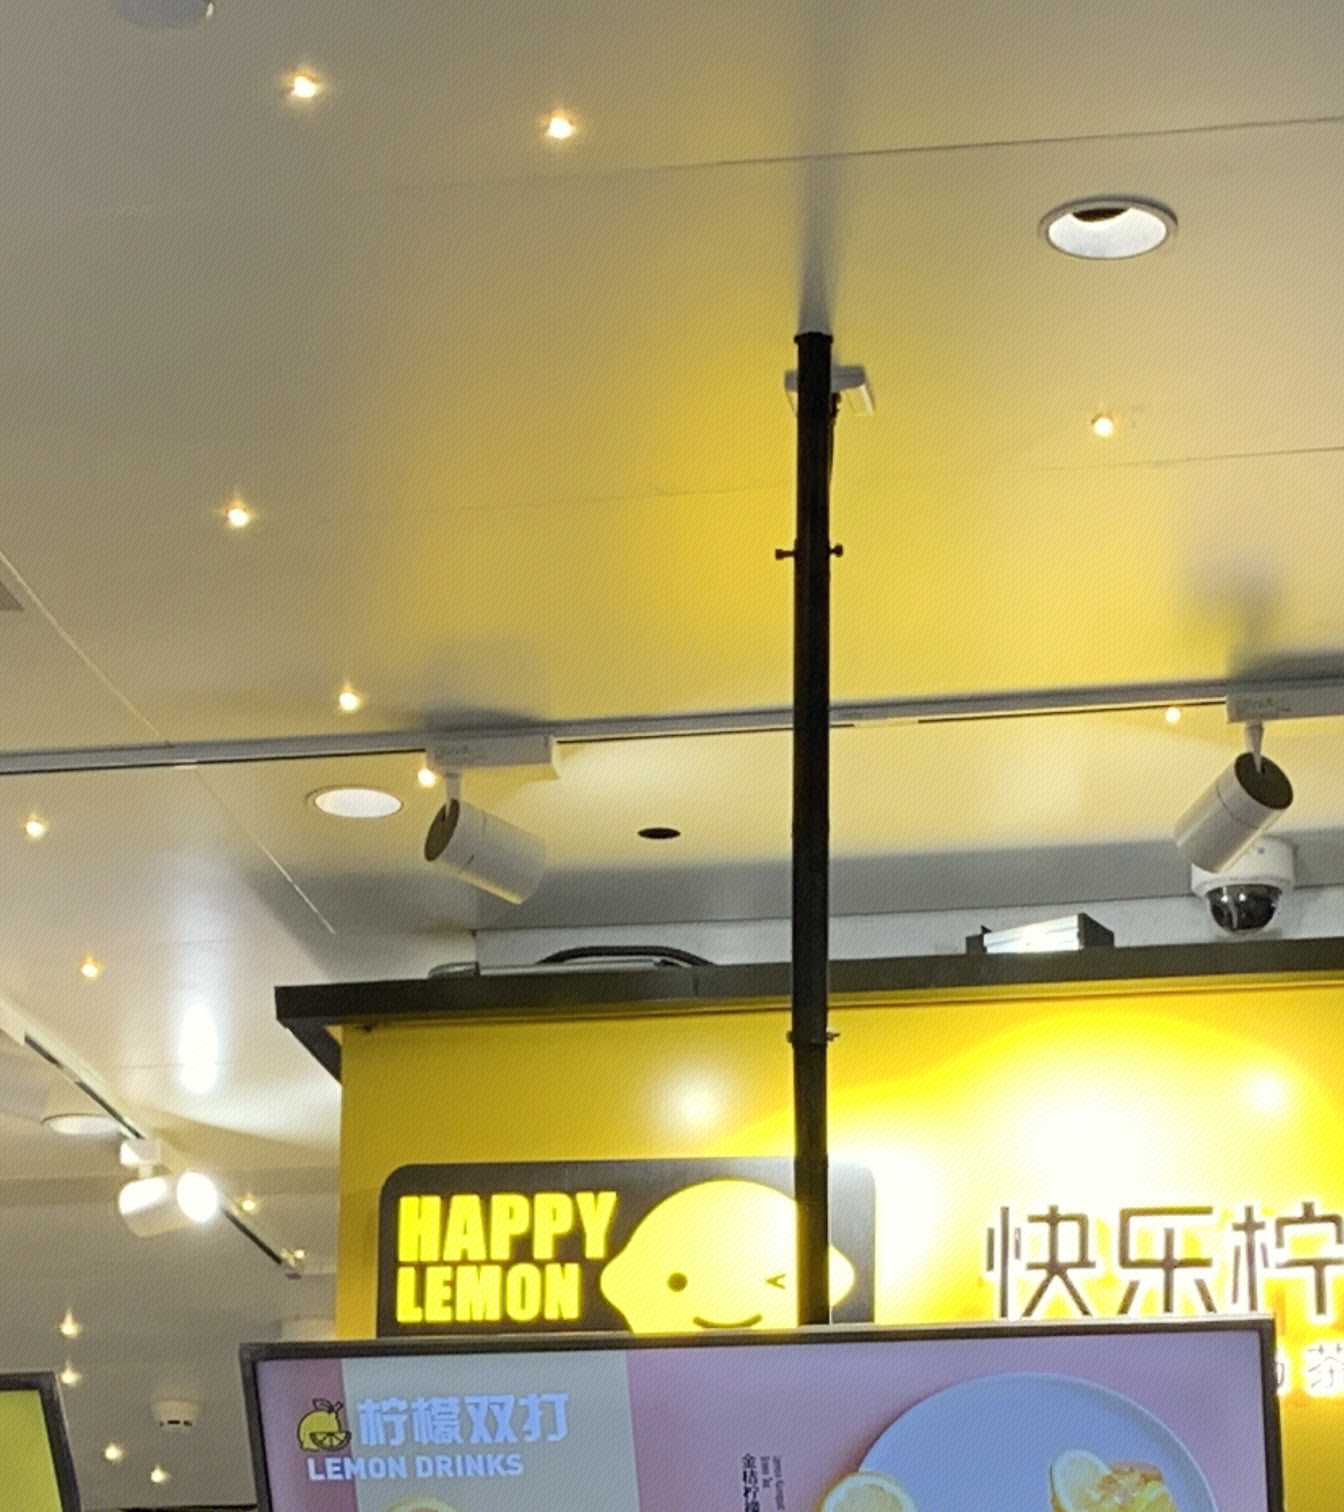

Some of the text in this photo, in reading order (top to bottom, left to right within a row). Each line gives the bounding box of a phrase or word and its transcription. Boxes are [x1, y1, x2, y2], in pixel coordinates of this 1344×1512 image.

[397, 1190, 618, 1263] HAPPY
[396, 1262, 581, 1323] LEMON
[357, 1391, 569, 1447] 柠檬双打
[307, 1453, 524, 1481] LEMON DRINKS
